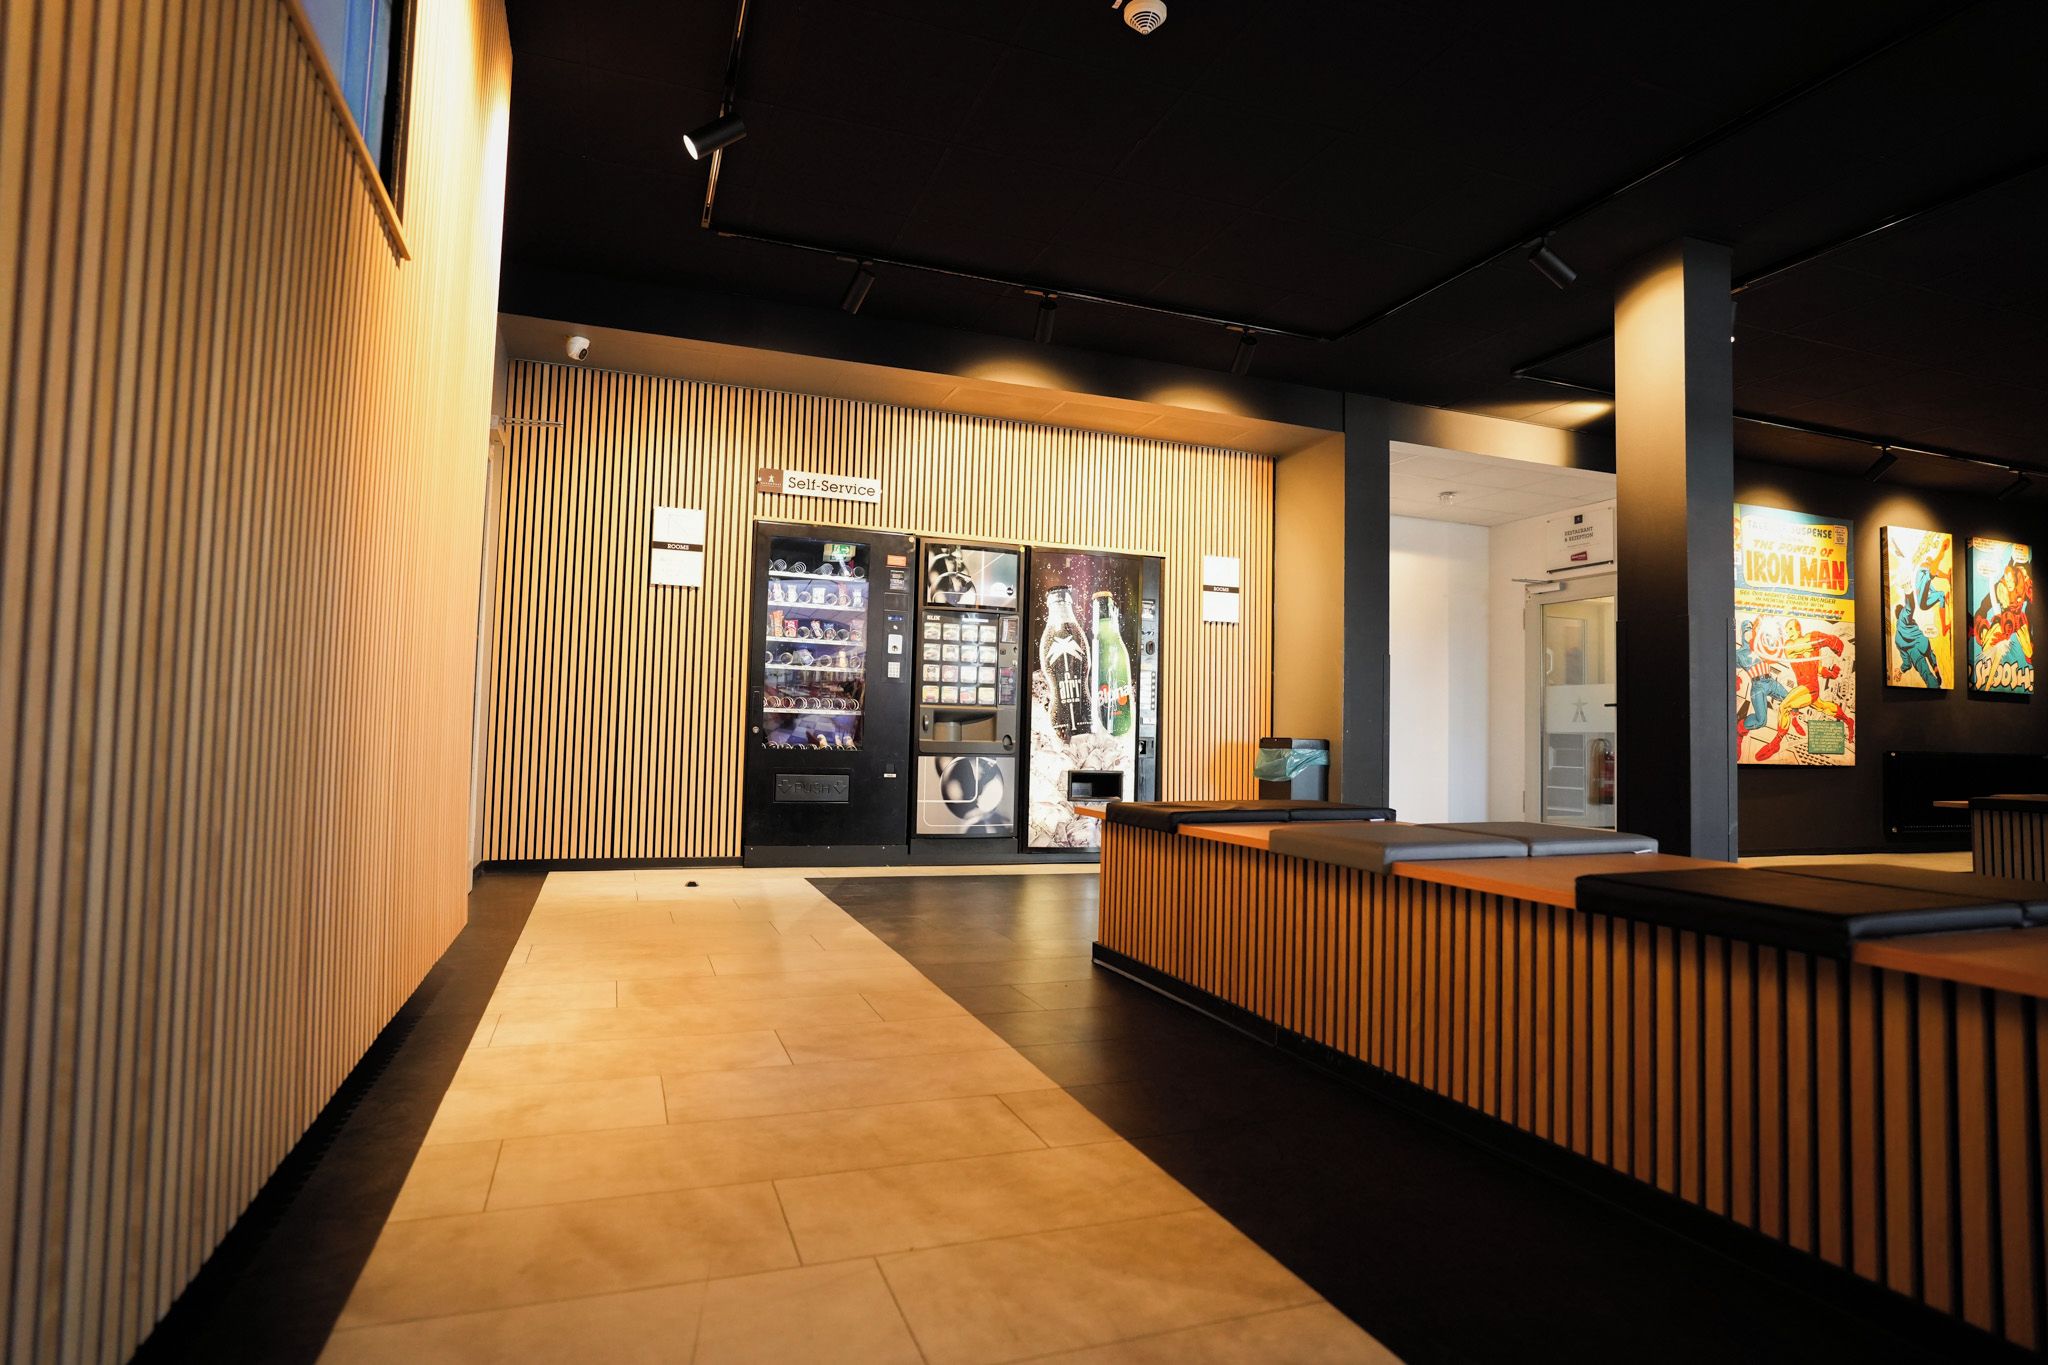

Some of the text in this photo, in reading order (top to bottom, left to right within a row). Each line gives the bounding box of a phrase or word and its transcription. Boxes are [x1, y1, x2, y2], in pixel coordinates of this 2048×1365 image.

[788, 476, 876, 497] Self-Service
[1564, 526, 1593, 536] RESTAURANT
[1753, 539, 1834, 558] THE POWER OF
[1746, 550, 1845, 591] IRON MAN
[1059, 672, 1081, 699] afri
[794, 782, 830, 794] PUSH
